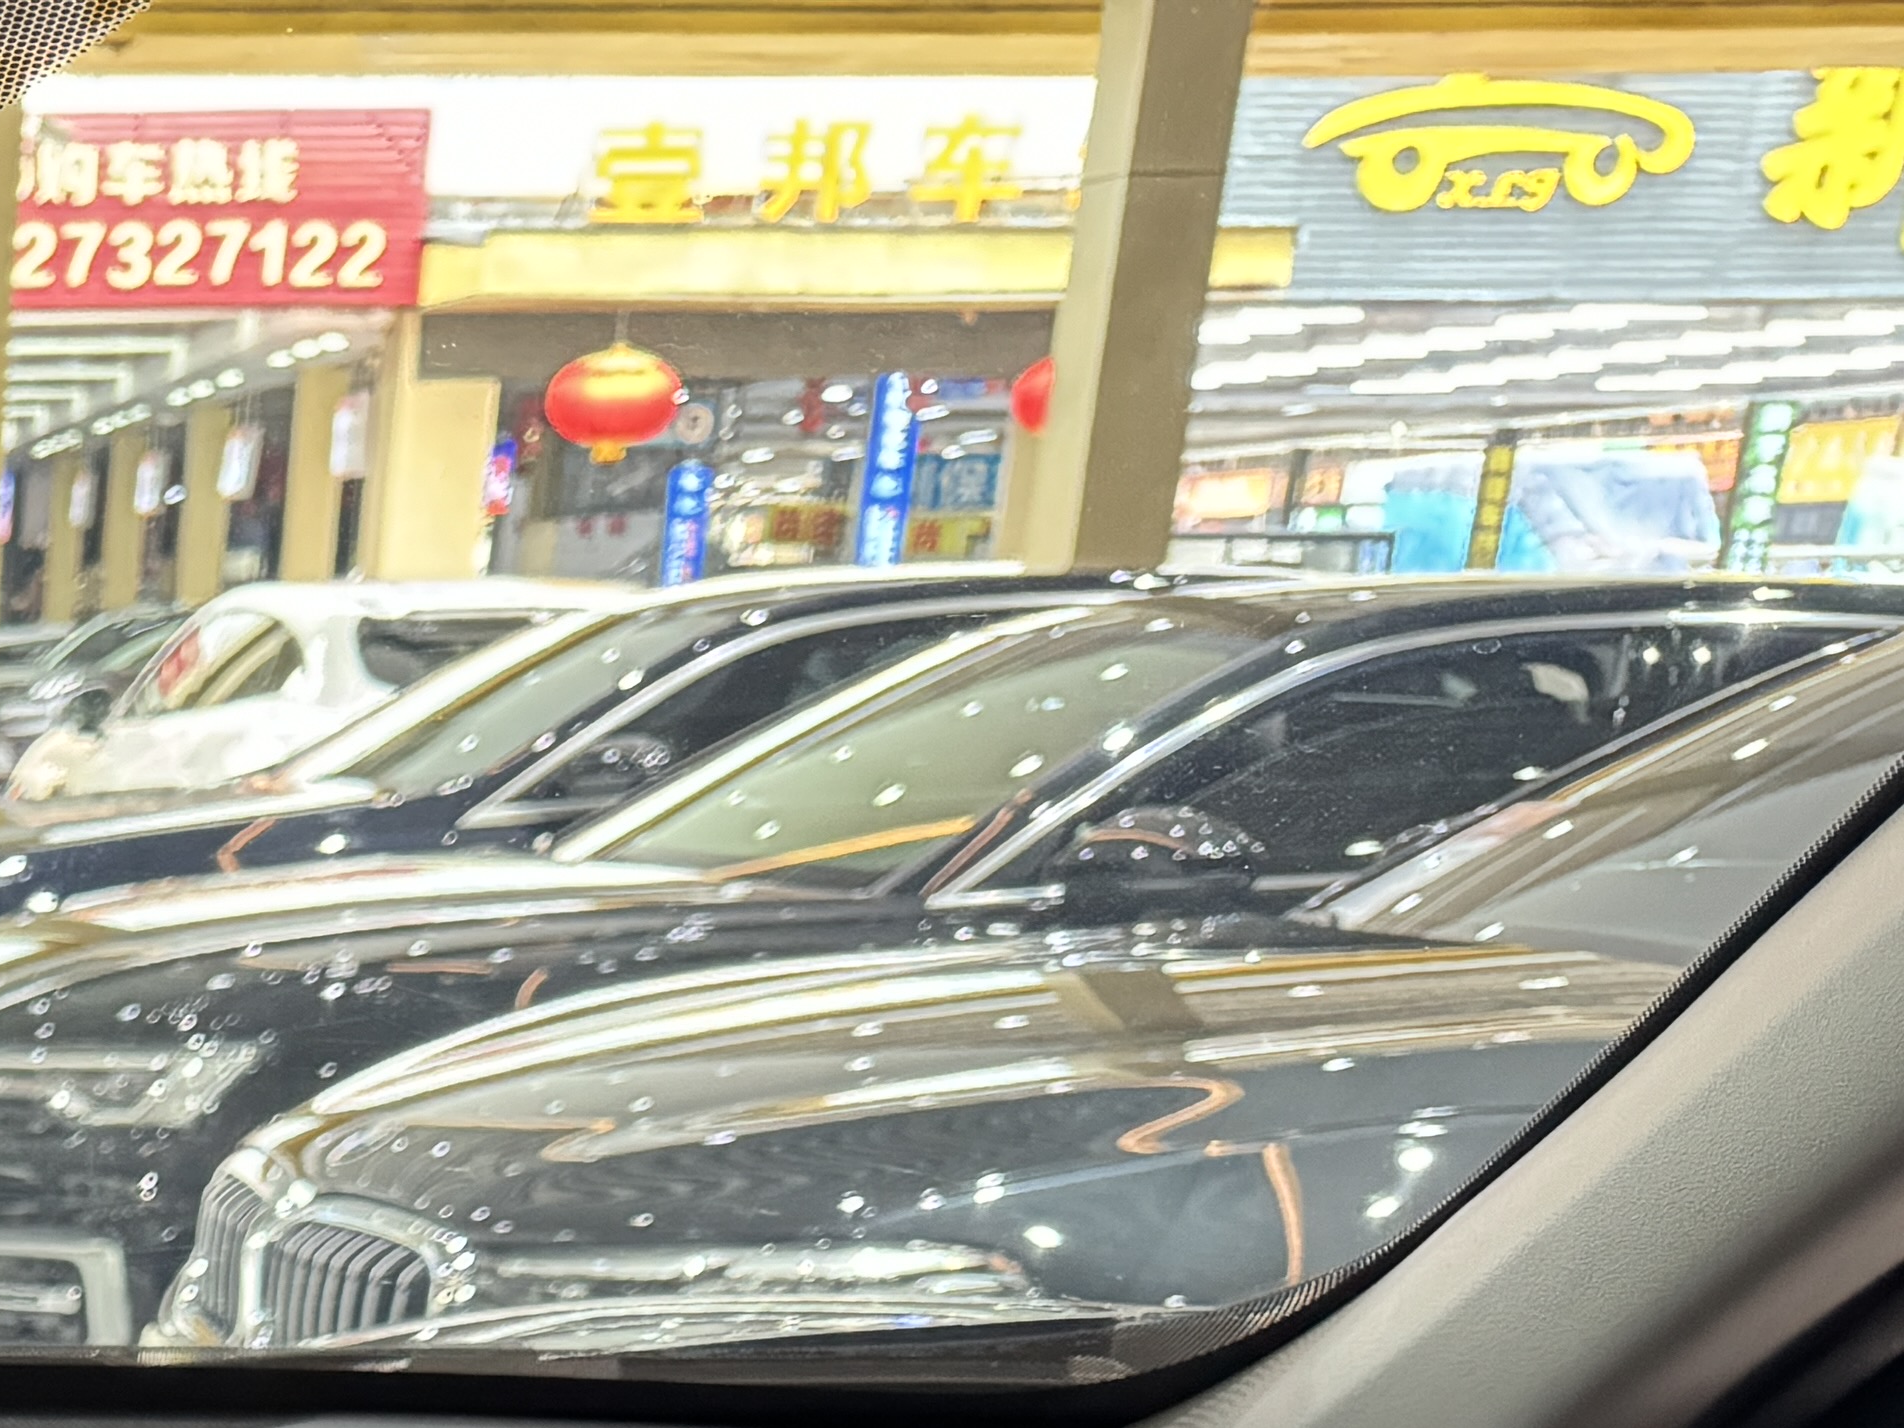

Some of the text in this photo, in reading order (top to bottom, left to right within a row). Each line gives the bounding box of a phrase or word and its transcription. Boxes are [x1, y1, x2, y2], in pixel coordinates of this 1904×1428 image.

[16, 137, 299, 207] 购车热线
[9, 218, 388, 291] 27327122
